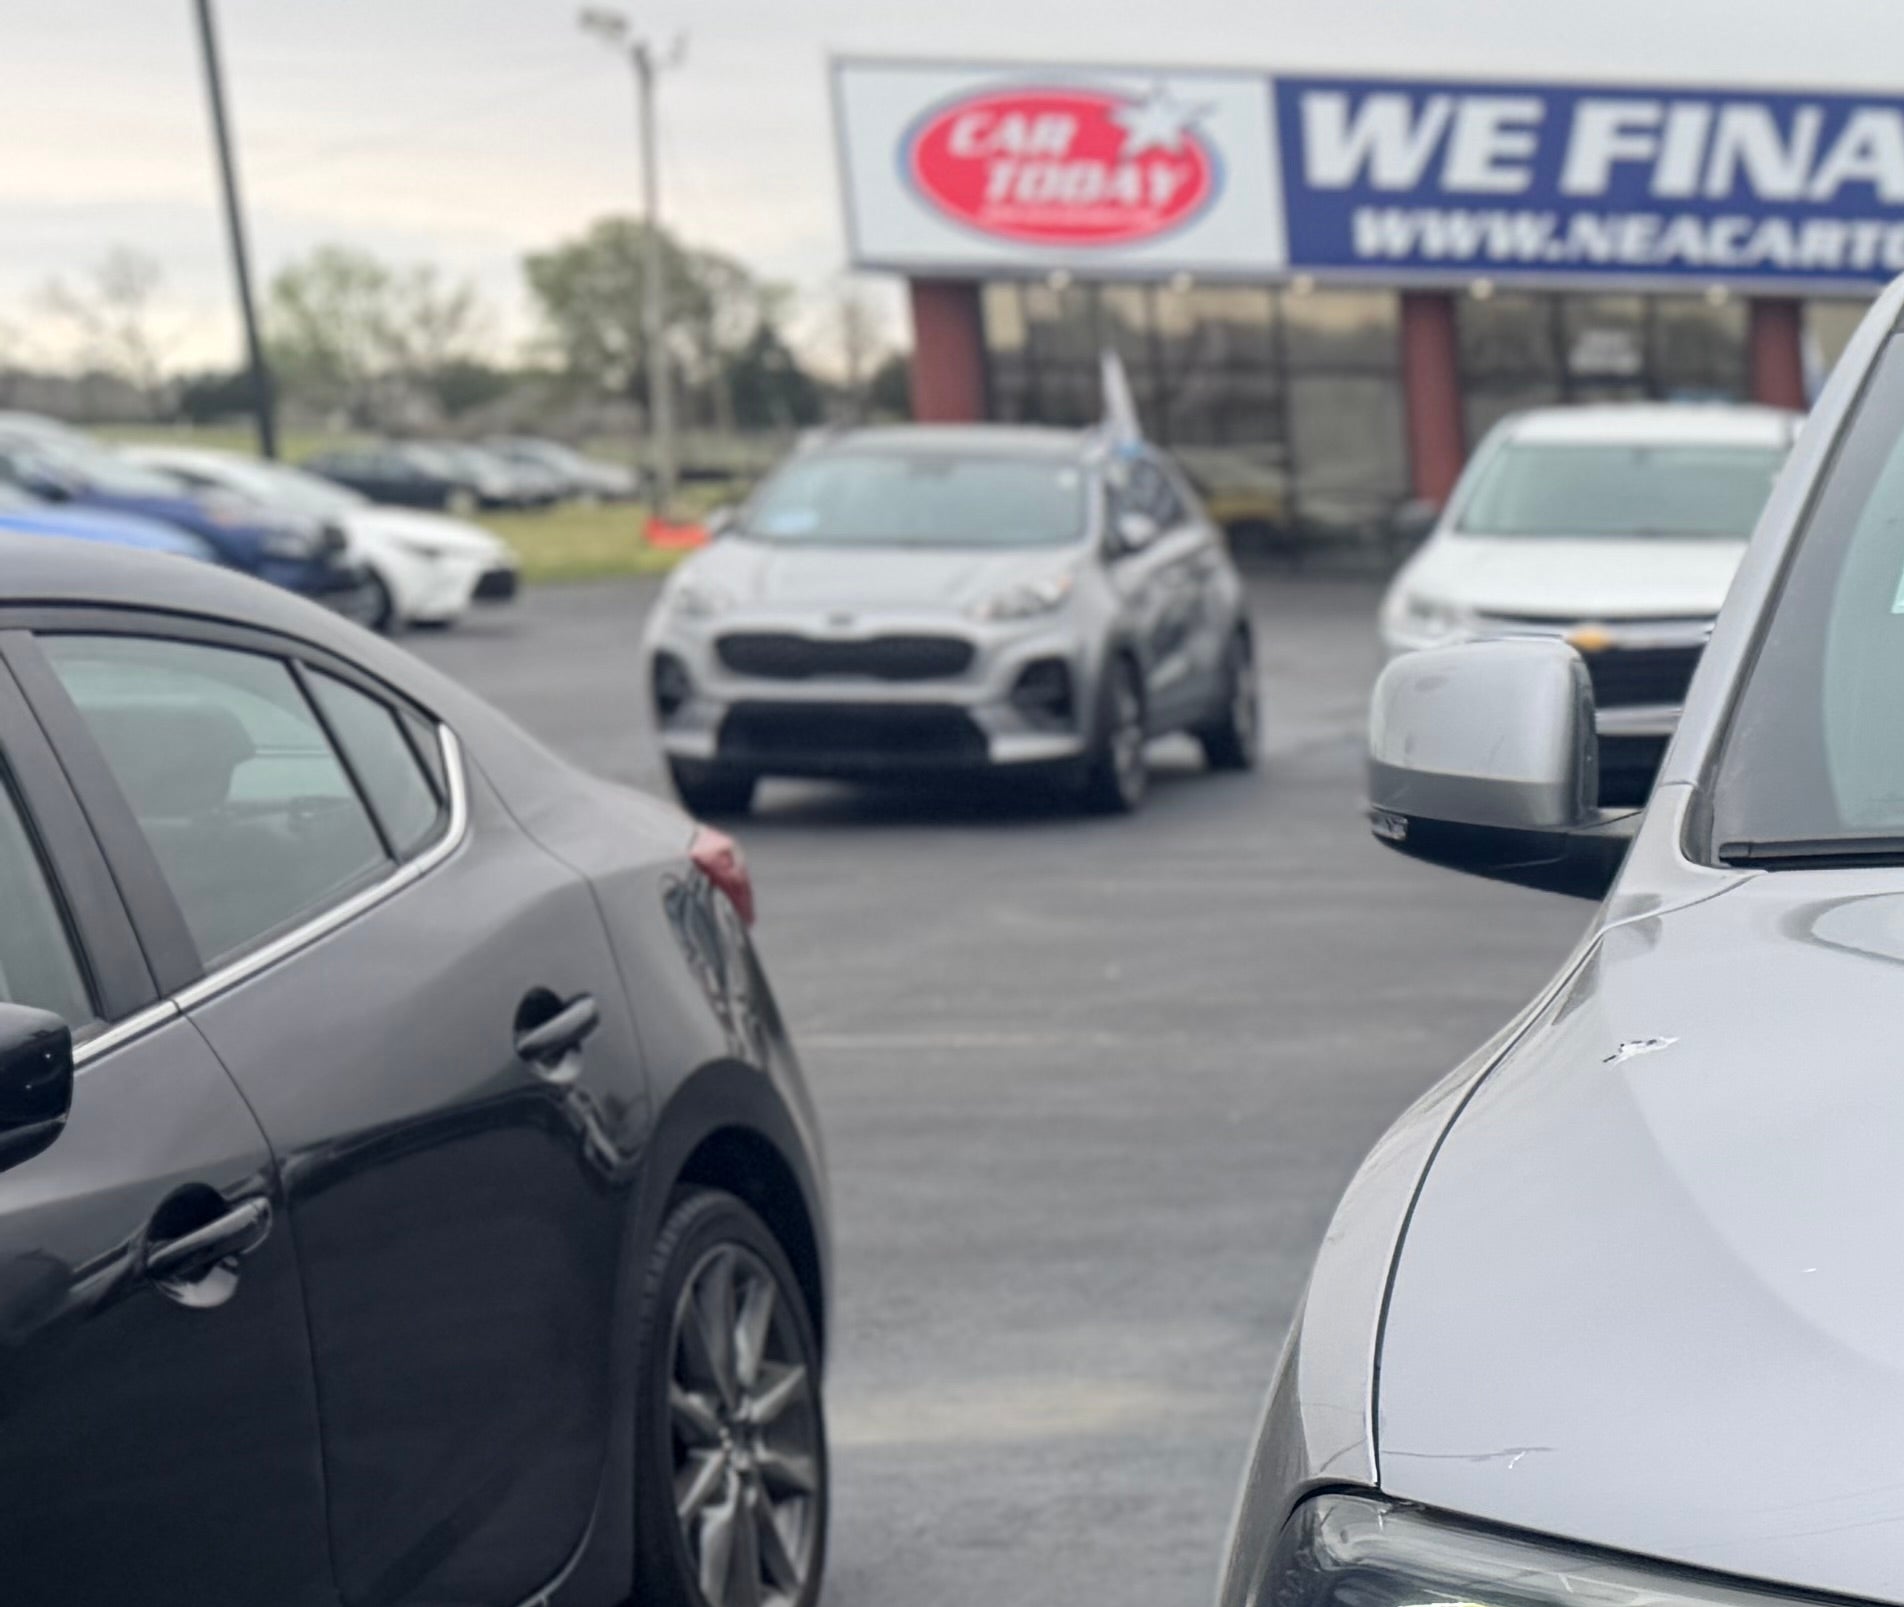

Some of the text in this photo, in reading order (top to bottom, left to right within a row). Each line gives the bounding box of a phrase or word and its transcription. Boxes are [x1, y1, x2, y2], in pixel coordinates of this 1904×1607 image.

[946, 109, 1079, 159] CAR
[1301, 90, 1547, 194] WE
[982, 157, 1191, 205] TODAY
